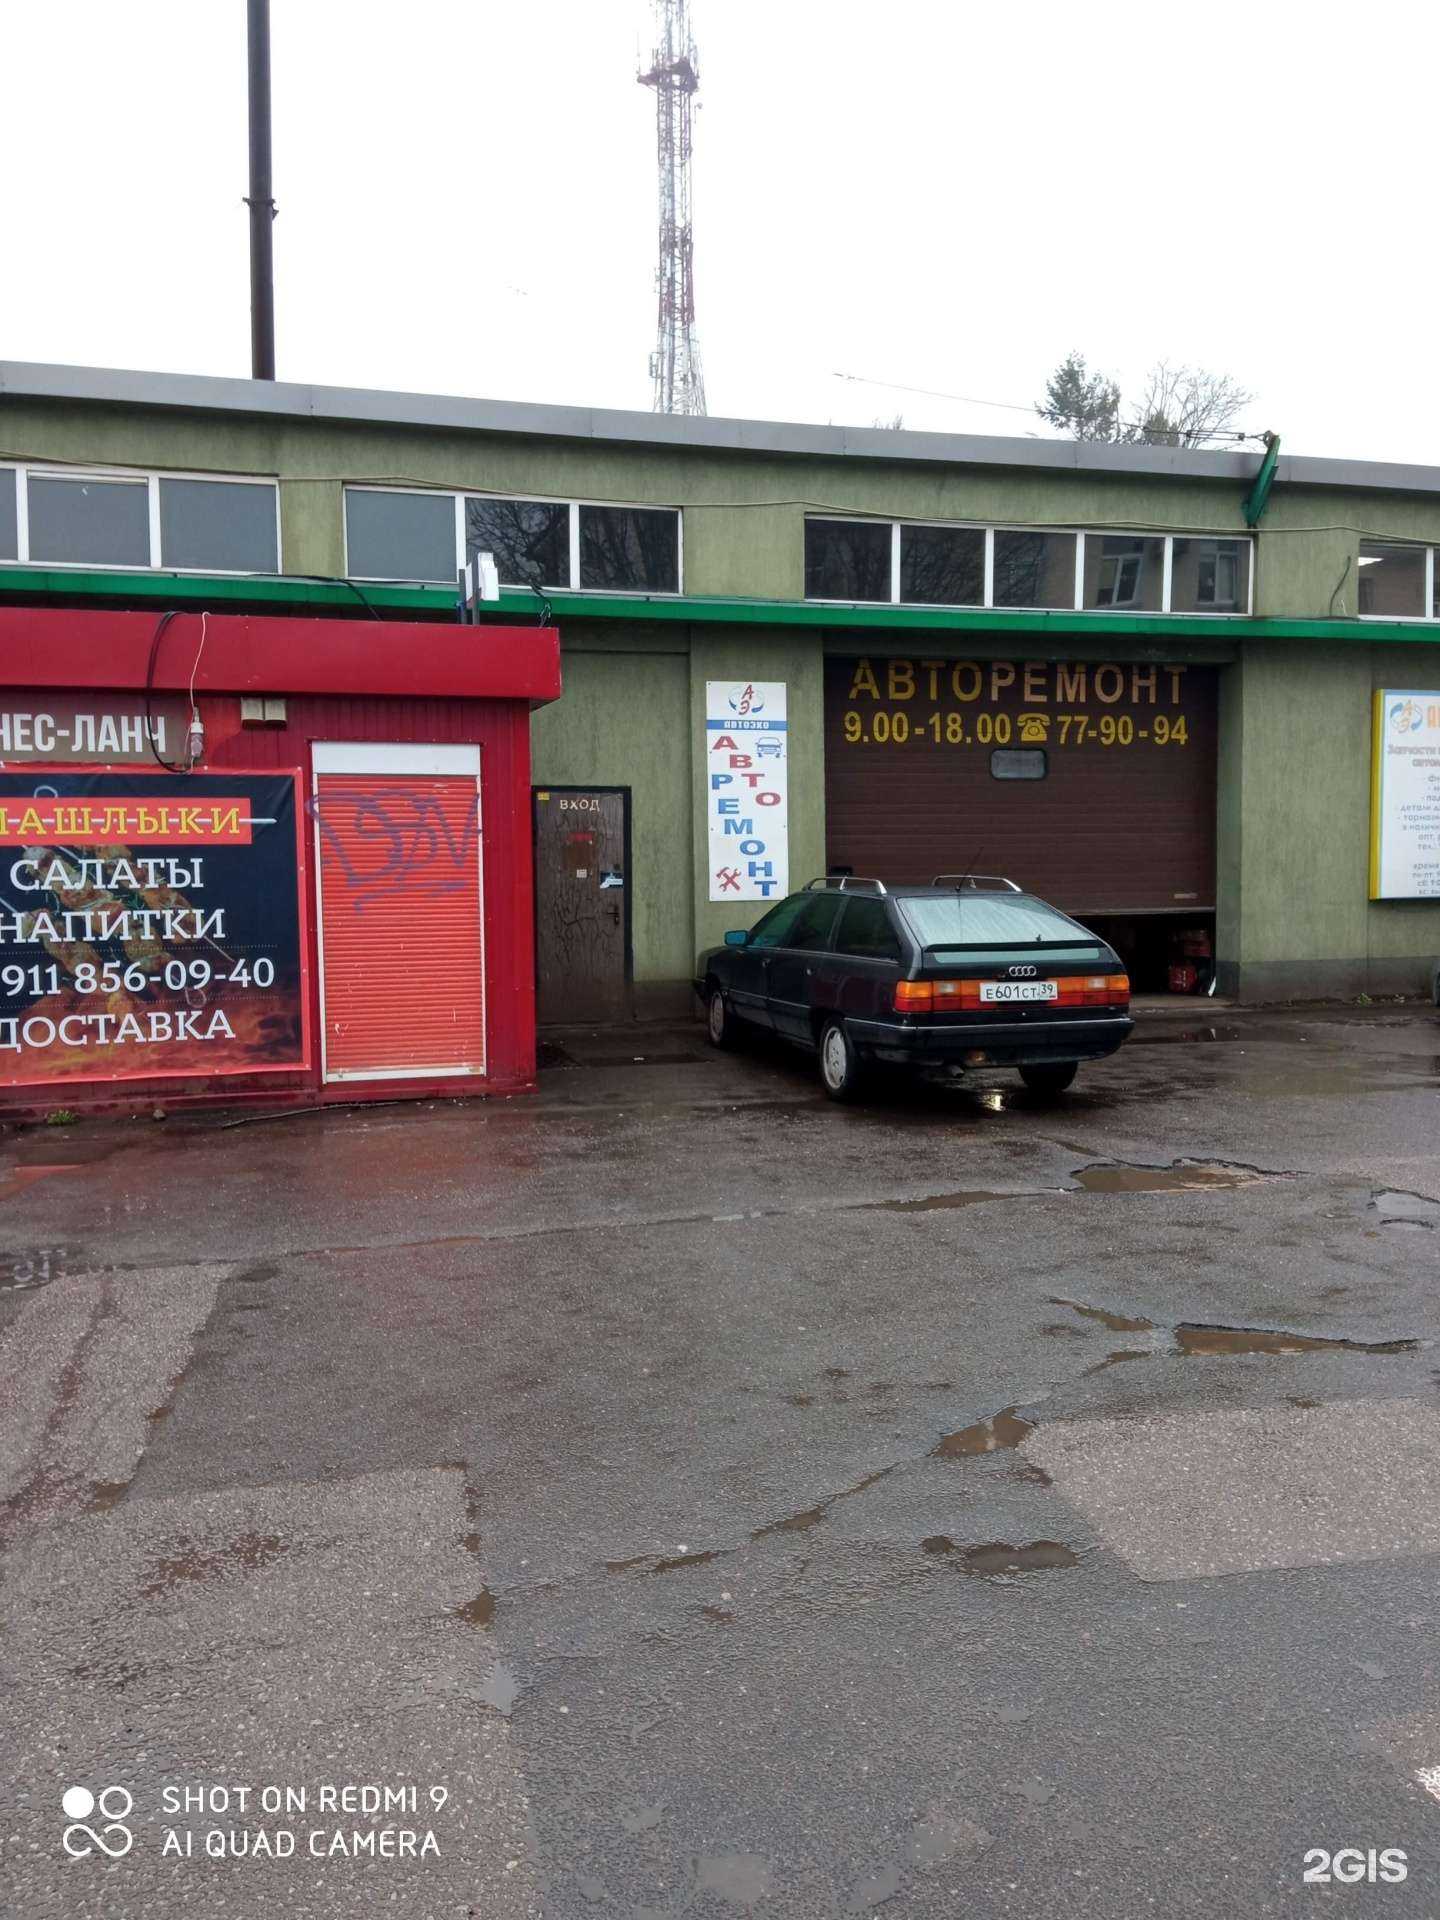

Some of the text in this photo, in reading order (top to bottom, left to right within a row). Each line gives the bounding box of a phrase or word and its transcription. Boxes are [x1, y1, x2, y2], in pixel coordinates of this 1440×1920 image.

[849, 659, 1188, 704] АВТОРЕМОНТ
[1056, 714, 1189, 745] 77-90-94
[0, 807, 241, 835] АШЛЫКИ
[560, 799, 600, 812] ВХОД
[10, 858, 204, 891] САЛАТЫ
[0, 908, 226, 944] НАПИТКИ
[1, 957, 275, 996] 911 856-09-40
[0, 1009, 236, 1053] ДОСТАВКА
